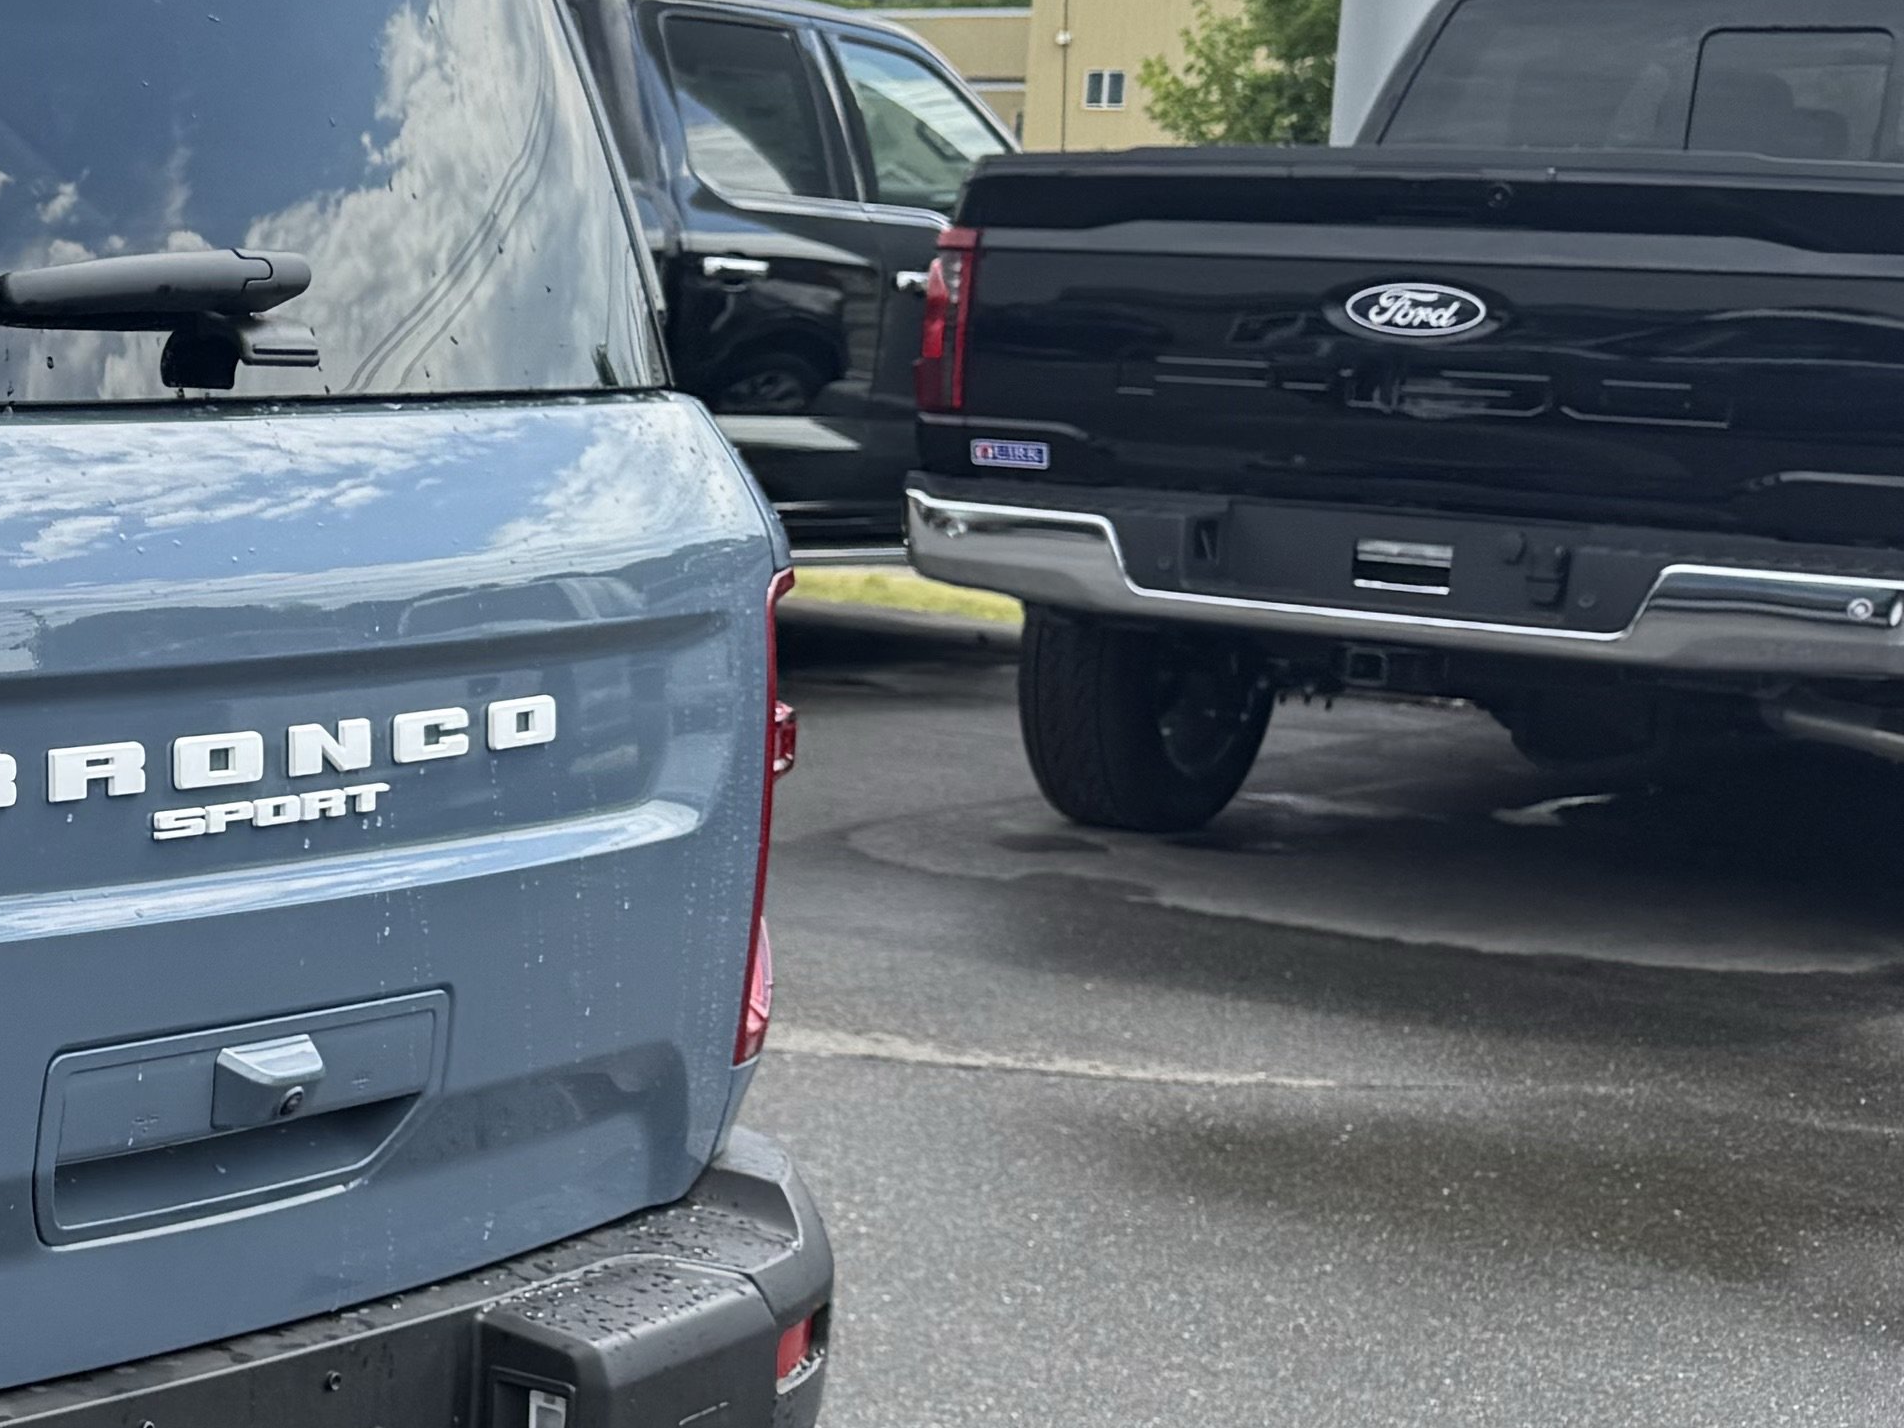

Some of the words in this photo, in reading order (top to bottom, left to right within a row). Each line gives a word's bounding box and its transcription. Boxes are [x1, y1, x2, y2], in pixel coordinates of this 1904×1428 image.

[1368, 288, 1461, 328] Ford
[975, 444, 1041, 462] QUIRK
[152, 782, 391, 842] SPORT
